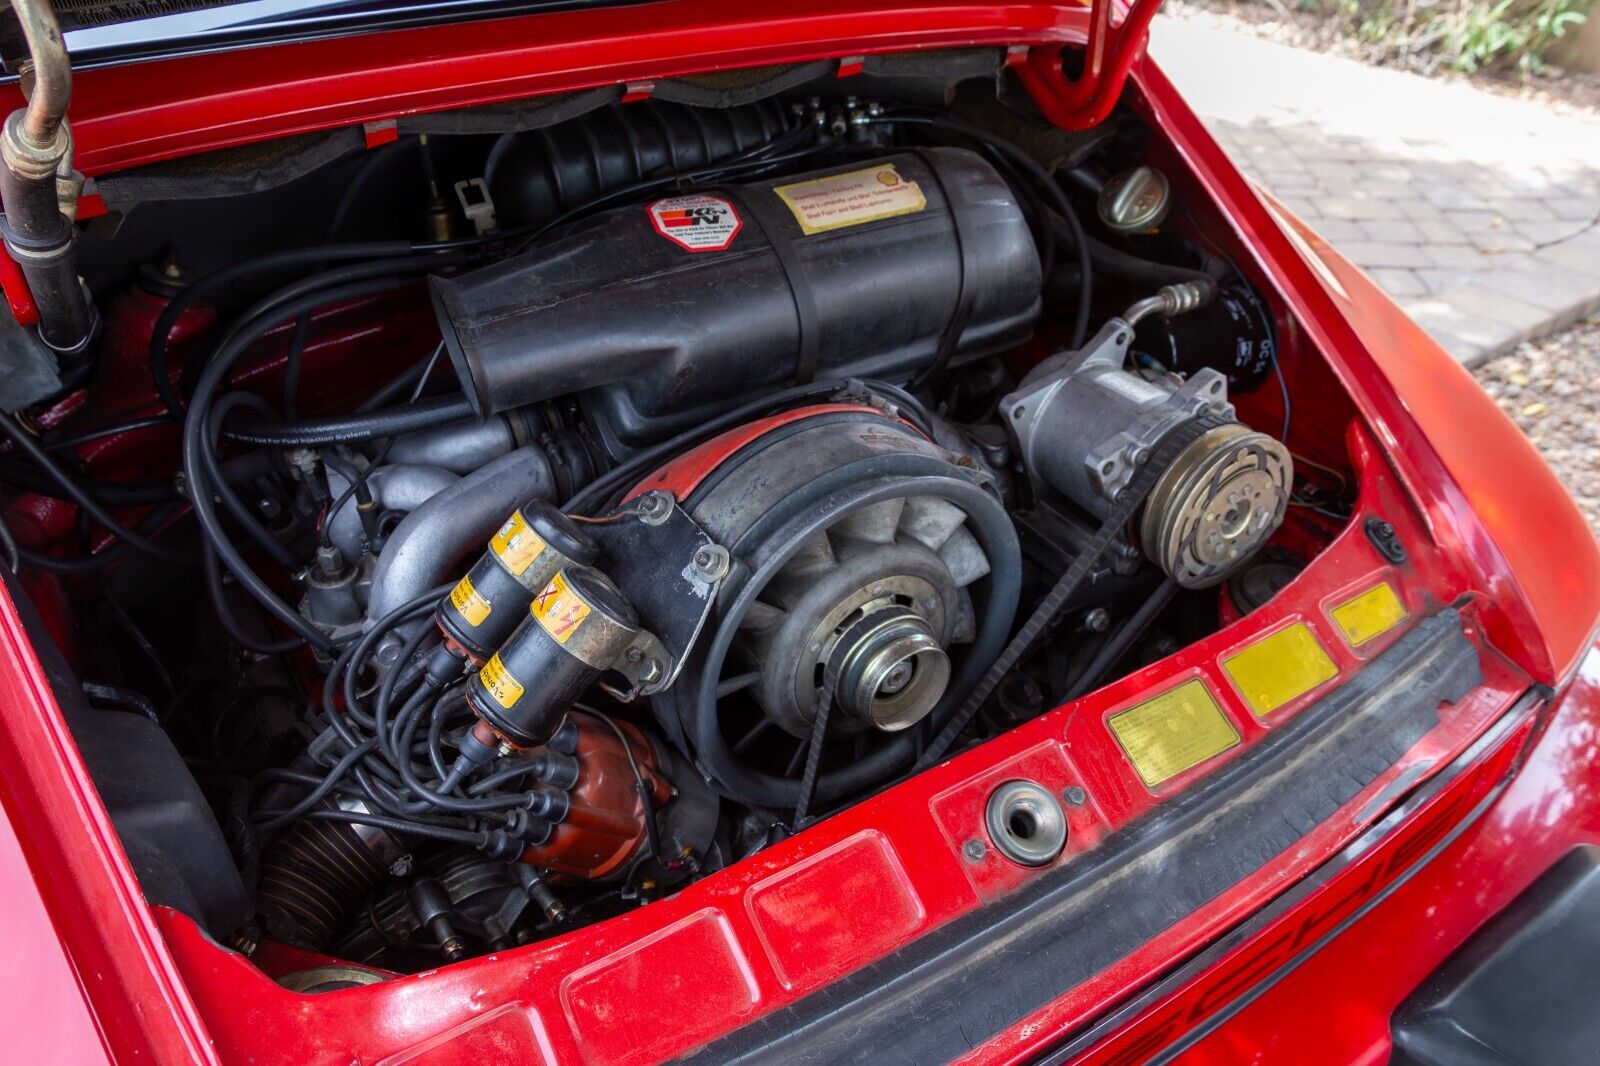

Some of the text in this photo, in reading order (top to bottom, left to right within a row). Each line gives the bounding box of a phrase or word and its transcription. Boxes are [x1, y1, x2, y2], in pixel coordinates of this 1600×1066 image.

[684, 207, 727, 226] K&N
[838, 205, 850, 213] and
[300, 435, 334, 444] Injection
[335, 429, 371, 441] Systems
